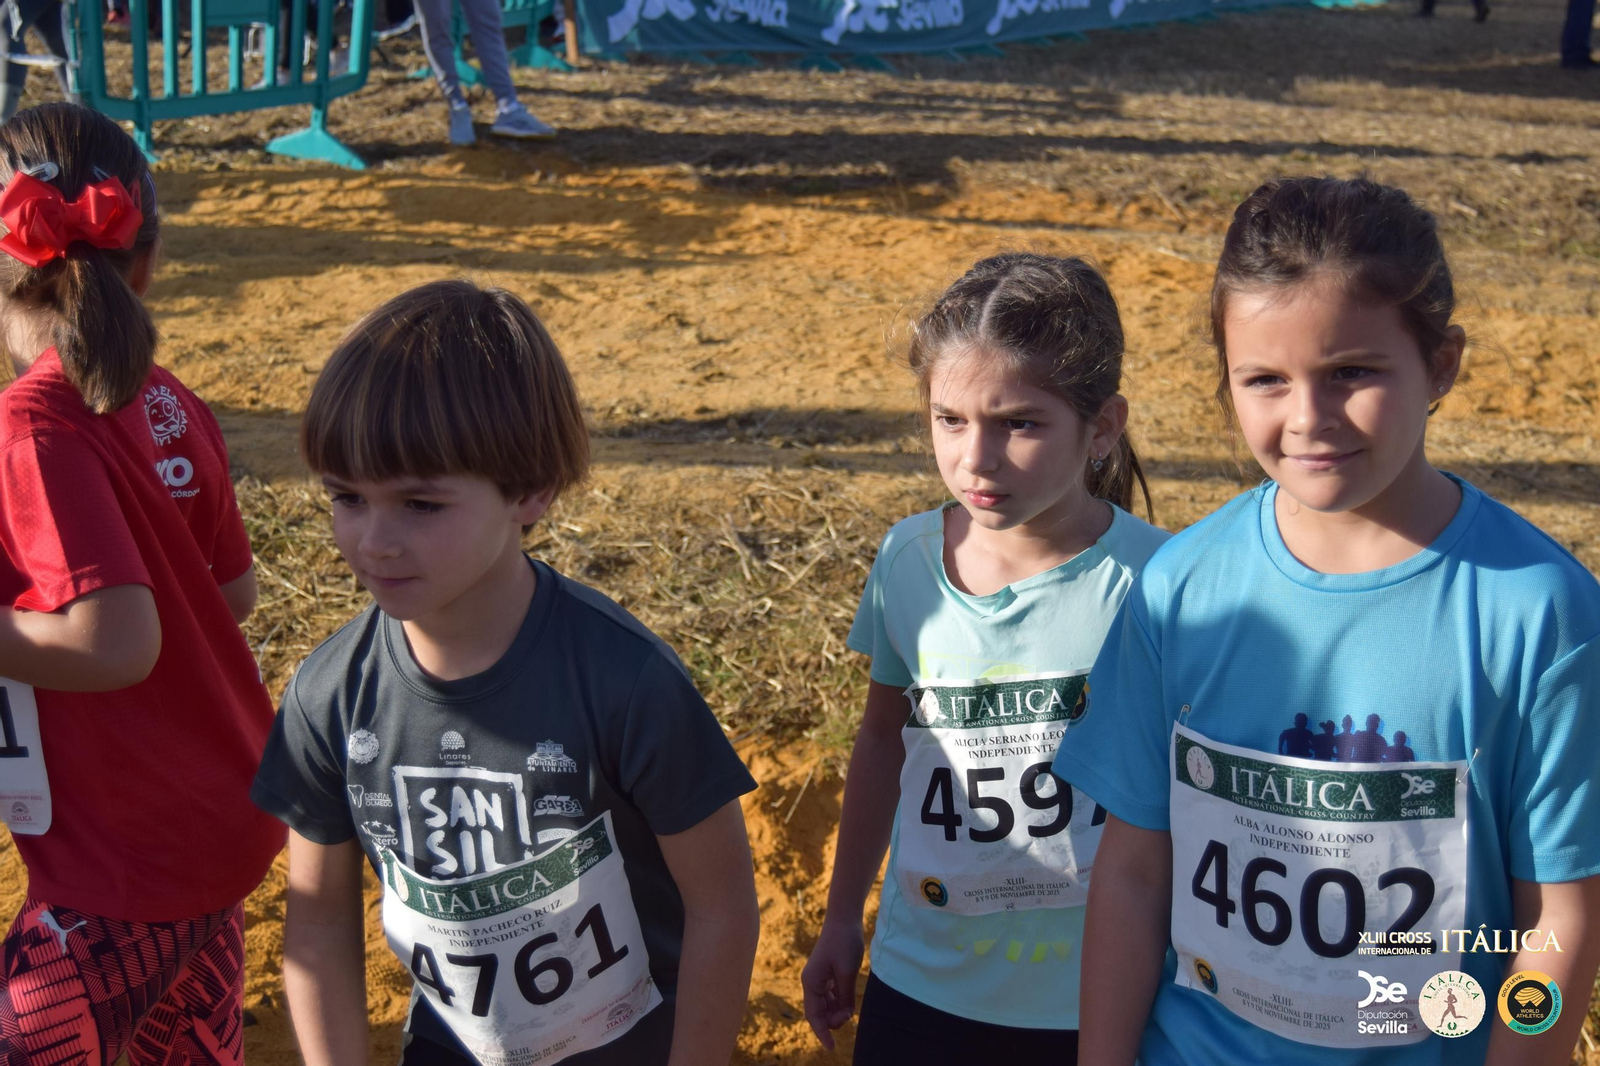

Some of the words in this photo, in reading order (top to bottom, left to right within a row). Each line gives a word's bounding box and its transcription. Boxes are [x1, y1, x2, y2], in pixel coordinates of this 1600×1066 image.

[950, 687, 1068, 720] ITÁLICA
[1011, 715, 1034, 723] CROSS
[1035, 712, 1069, 721] COUNTRY
[954, 737, 987, 748] ALICIA
[989, 732, 1040, 746] SERRANO
[1042, 729, 1066, 741] LEO
[969, 743, 1055, 759] INDEPENDIENTE
[543, 765, 578, 774] LINARES
[365, 792, 391, 800] DENTAL
[1230, 765, 1375, 811] ITÁLICA
[420, 786, 504, 831] SAN
[1232, 794, 1296, 815] INTERNATIONAL
[1298, 809, 1327, 819] CROSS
[1330, 812, 1375, 820] COUNTRY
[1400, 805, 1436, 817] Sevilla
[1233, 815, 1260, 831] ALBA
[1263, 823, 1314, 841] ALONSO
[1317, 832, 1374, 844] ALONSO
[426, 829, 507, 875] SIL
[1250, 832, 1351, 859] INDEPENDIENTE
[419, 869, 552, 914] ITÁLICA
[425, 909, 486, 921] INTERNATIONAL
[490, 902, 515, 915] CROSS
[517, 886, 555, 905] COUNTRY
[964, 889, 984, 898] CROSS
[984, 883, 1035, 896] INTERNACIONAL
[1000, 890, 1036, 899] NOVIEMBRE
[1191, 839, 1437, 958] 4602
[427, 924, 470, 937] MARTIN
[472, 913, 532, 937] PACHECO
[534, 899, 563, 917] RUIZ
[449, 919, 545, 948] INDEPENDIENTE
[411, 903, 629, 1018] 4761
[1232, 987, 1250, 1000] CROSS
[1251, 995, 1301, 1018] INTERNACIONAL
[1303, 1011, 1313, 1020] DE
[1255, 1004, 1264, 1014] DE
[1264, 1008, 1301, 1026] NOVIEMBRE
[1302, 1020, 1314, 1029] DE
[1314, 1021, 1331, 1030] 2025
